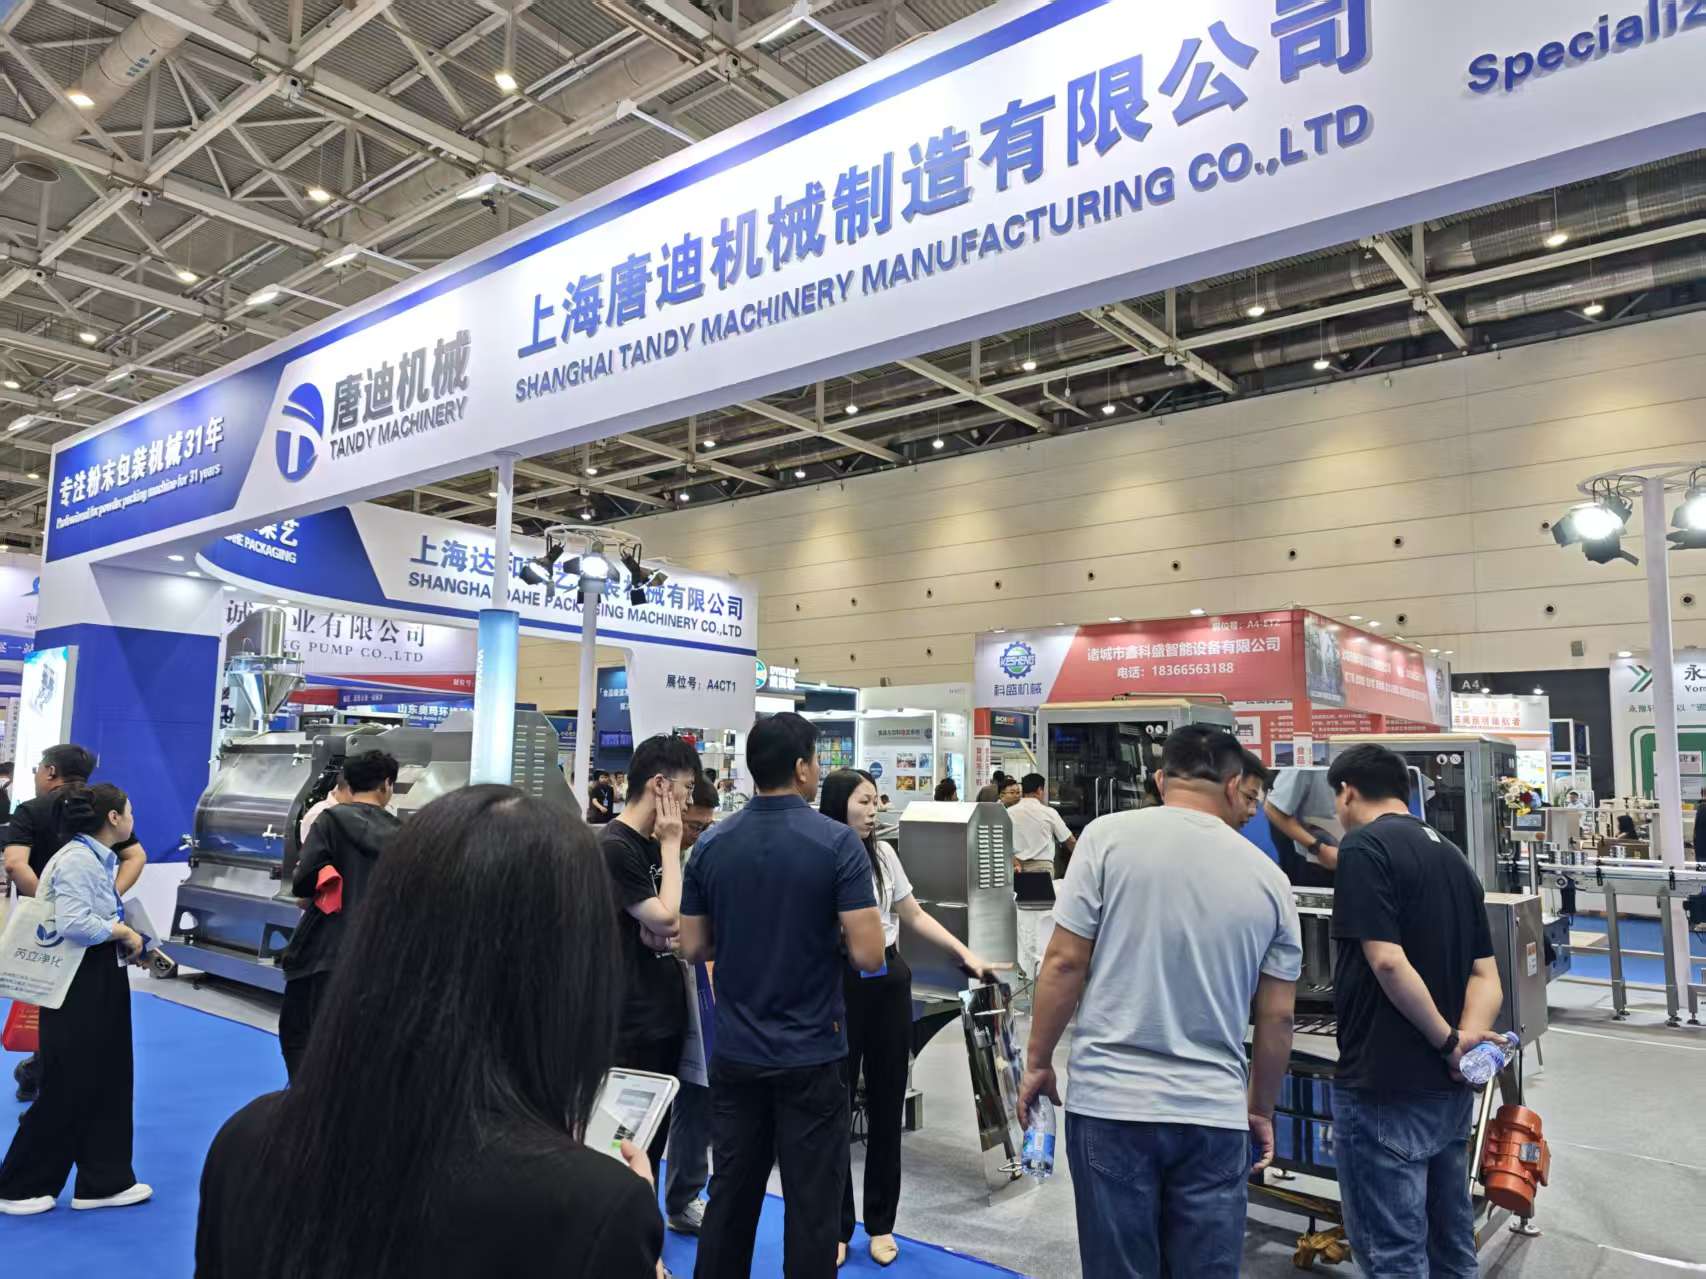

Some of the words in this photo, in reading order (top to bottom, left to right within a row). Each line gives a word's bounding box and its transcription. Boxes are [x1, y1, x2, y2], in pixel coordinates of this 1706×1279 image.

[517, 0, 1373, 359] 上海唐迪机械制造有限公司
[515, 349, 614, 402] SHANGHAI
[618, 323, 695, 379] TANDY
[701, 270, 855, 345] MACHINERY
[861, 166, 1176, 296] MANUFACTURING
[331, 329, 471, 435] 唐迪机械
[329, 426, 377, 461] TANDY
[377, 396, 469, 446] MACHINERY
[244, 536, 297, 565] PACKAGING
[408, 571, 492, 599] SHANGHA
[507, 589, 541, 606] AHE
[627, 608, 699, 631] MACHINERY
[308, 642, 353, 657] PUMP
[1151, 662, 1234, 677] 18366563188
[1684, 664, 1706, 681] 永
[706, 679, 737, 694] A4CT1
[1461, 679, 1480, 690] A4
